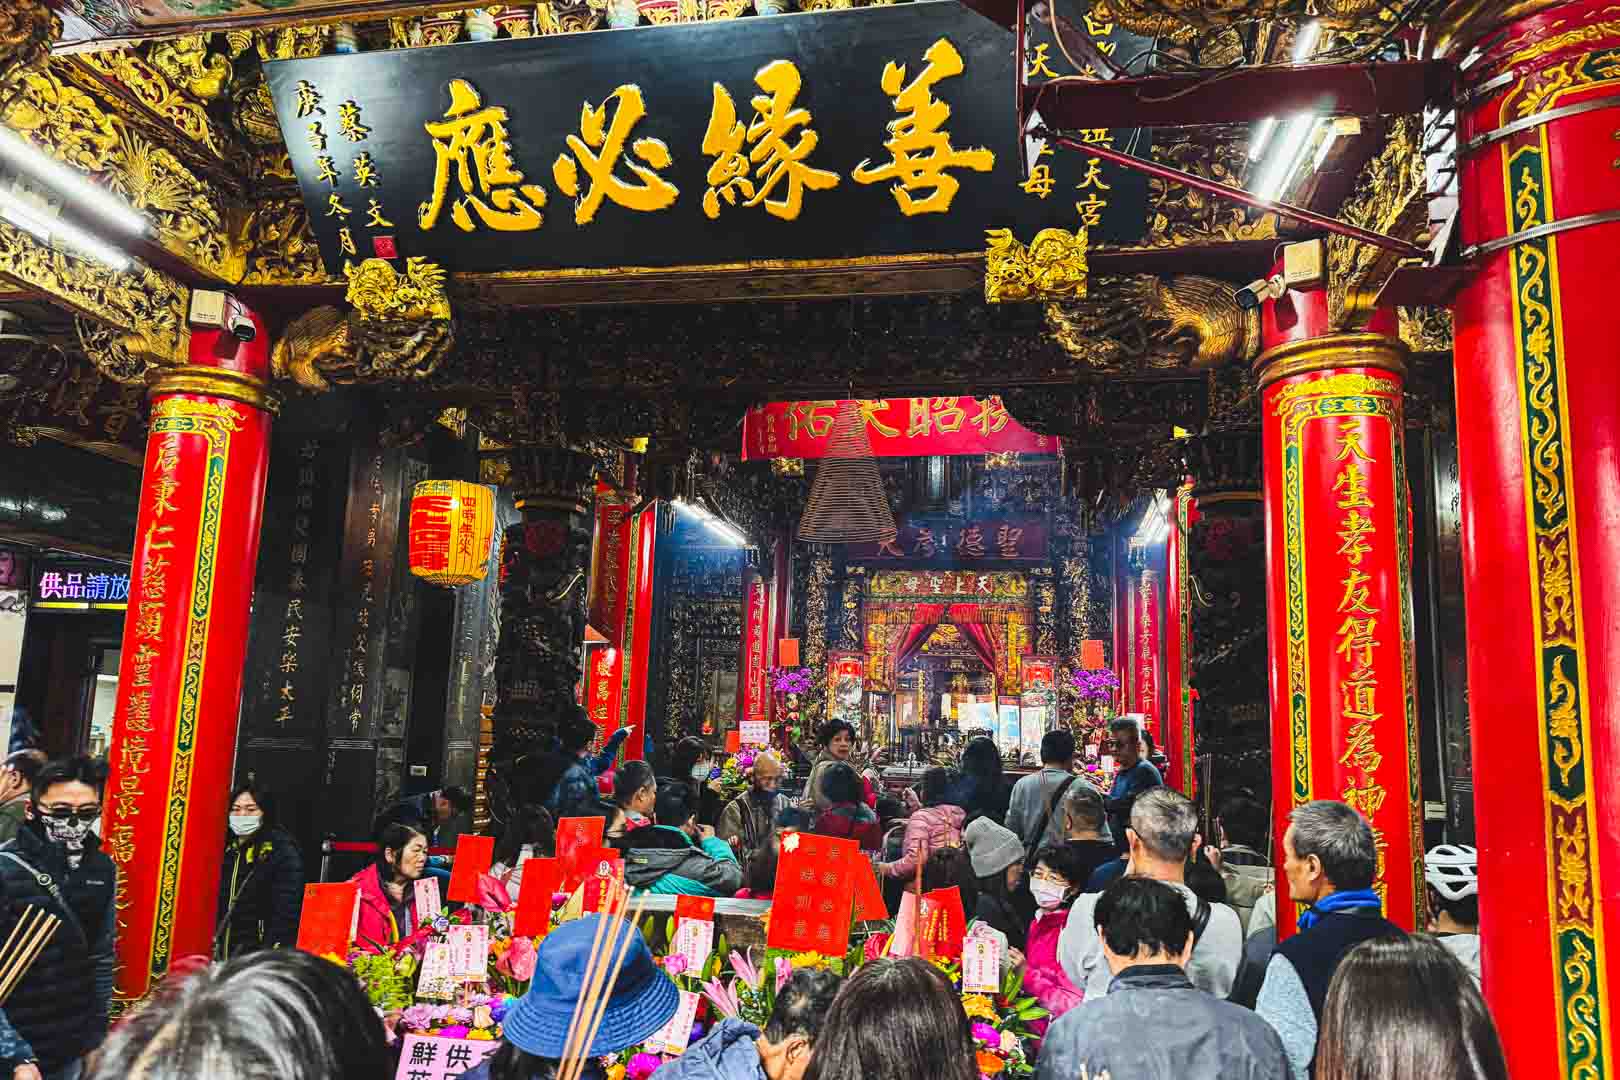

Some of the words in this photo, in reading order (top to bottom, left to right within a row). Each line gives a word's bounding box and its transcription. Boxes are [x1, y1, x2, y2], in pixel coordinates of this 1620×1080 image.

[293, 80, 357, 257] 庚子年冬月
[337, 100, 396, 227] 蔡英文
[417, 37, 996, 232] 善緣必應
[39, 572, 130, 600] 供品請放
[904, 575, 993, 596] 天上聖母
